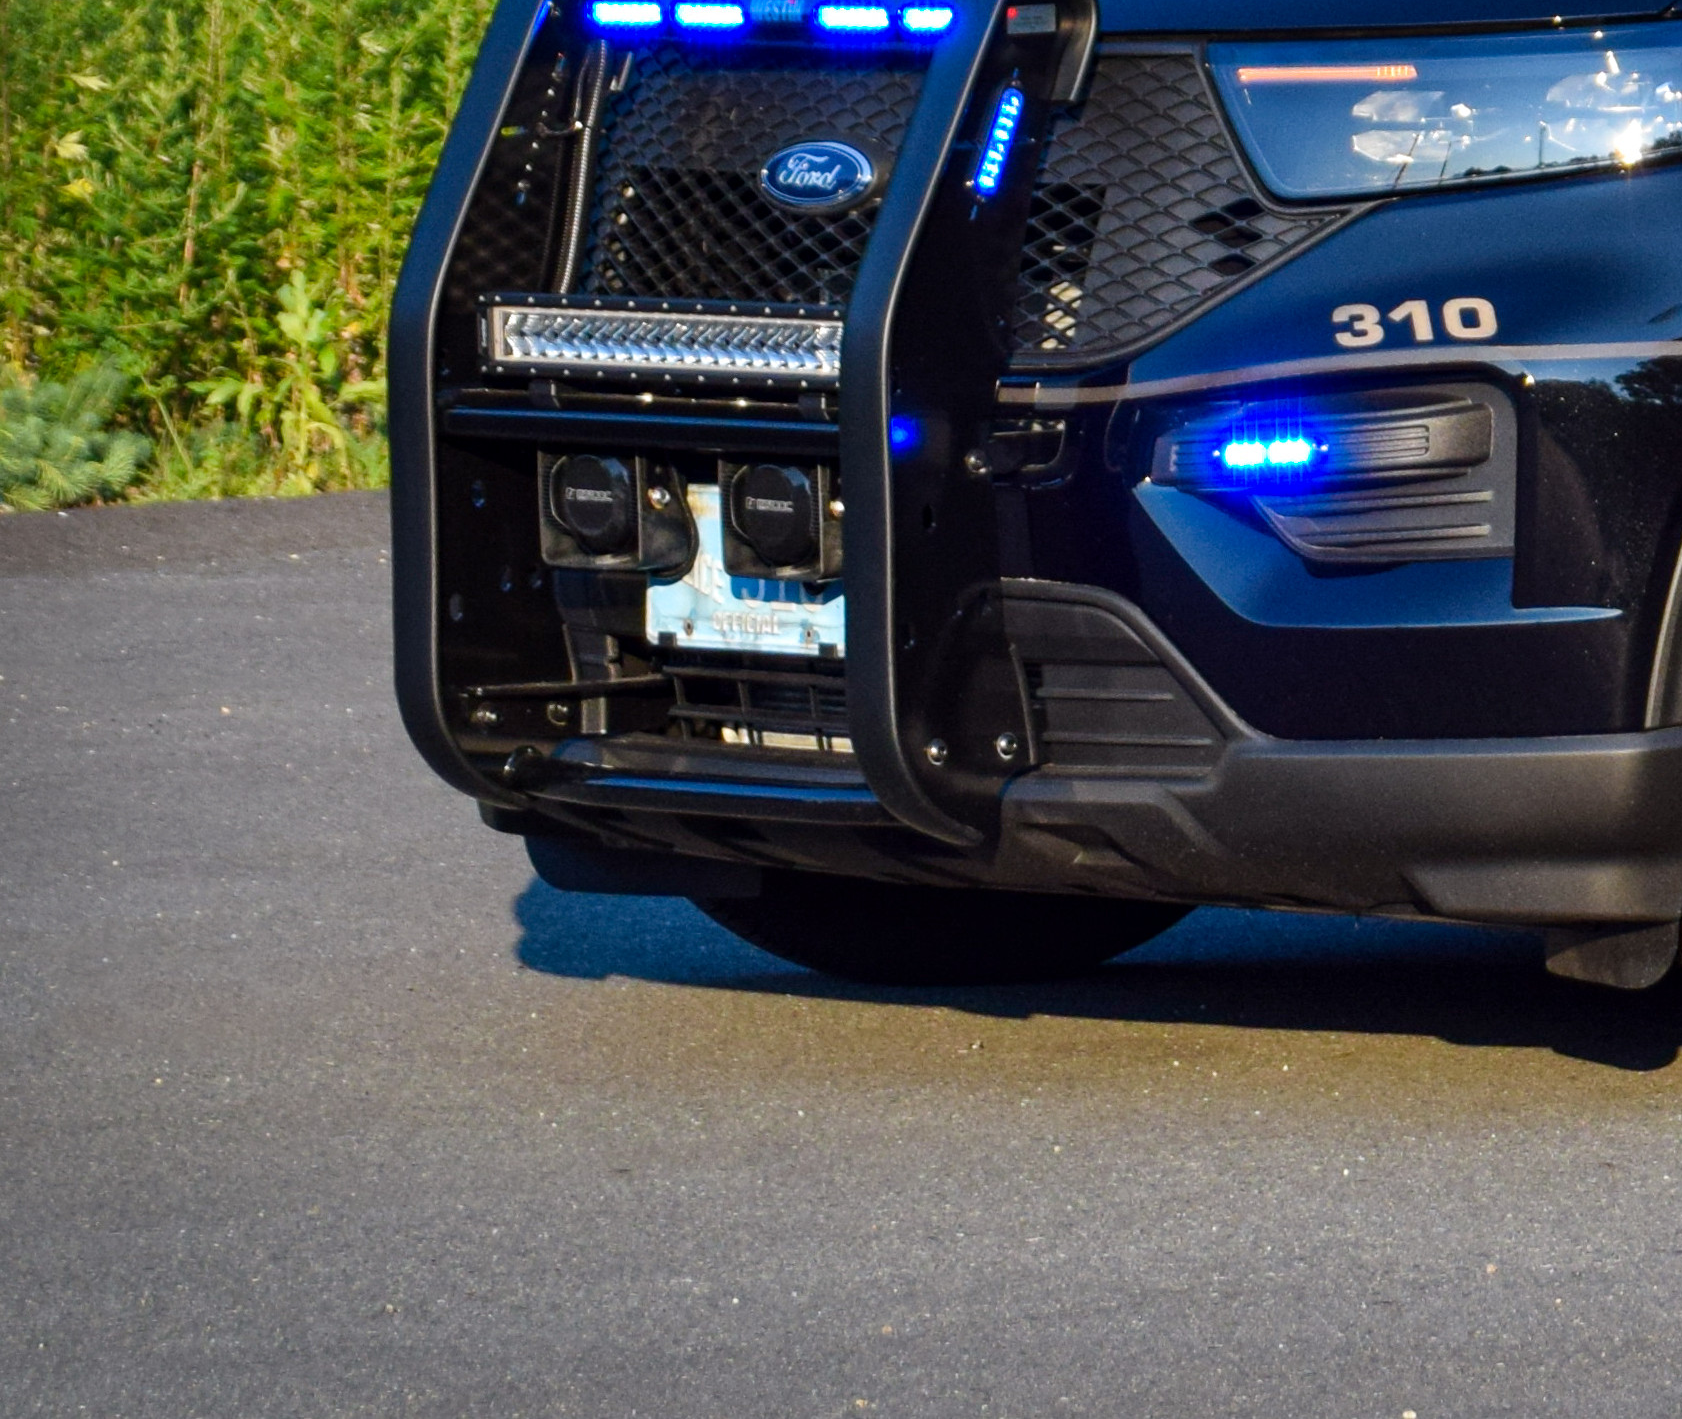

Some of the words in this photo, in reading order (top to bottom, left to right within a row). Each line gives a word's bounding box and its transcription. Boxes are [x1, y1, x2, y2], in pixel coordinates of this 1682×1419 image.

[778, 152, 842, 190] Ford
[1331, 297, 1498, 349] 310
[711, 610, 781, 635] OFFICIAL
